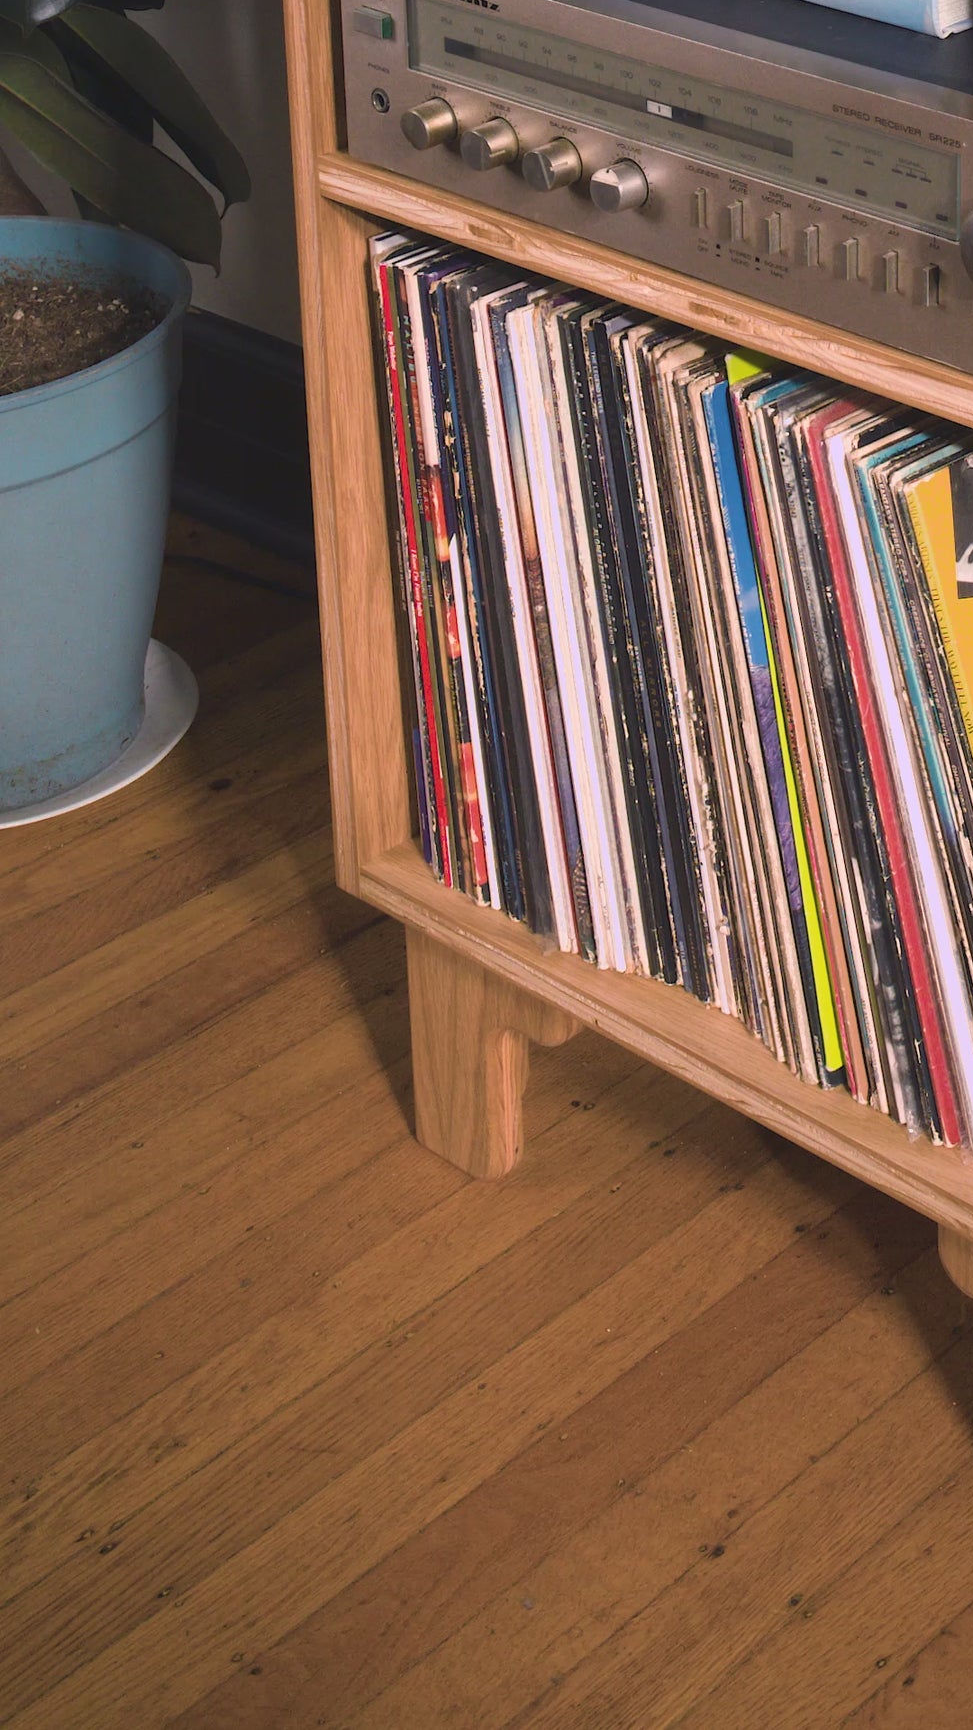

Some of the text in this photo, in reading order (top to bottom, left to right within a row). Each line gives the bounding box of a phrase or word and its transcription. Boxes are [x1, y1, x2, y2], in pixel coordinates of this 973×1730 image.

[648, 78, 662, 88] 102
[678, 86, 693, 97] 104
[708, 95, 722, 106] 106
[549, 120, 578, 135] BALANCE
[832, 104, 871, 122] STEREO
[874, 116, 922, 137] RECEIVER
[616, 142, 642, 156] VOLUME
[386, 330, 398, 370] Faye Webster
[402, 315, 416, 383] MALIBU
[592, 365, 601, 394] LEGEND
[905, 493, 923, 538] VARIOUS
[907, 598, 927, 649] CREEDENCE
[946, 649, 957, 670] WAY
